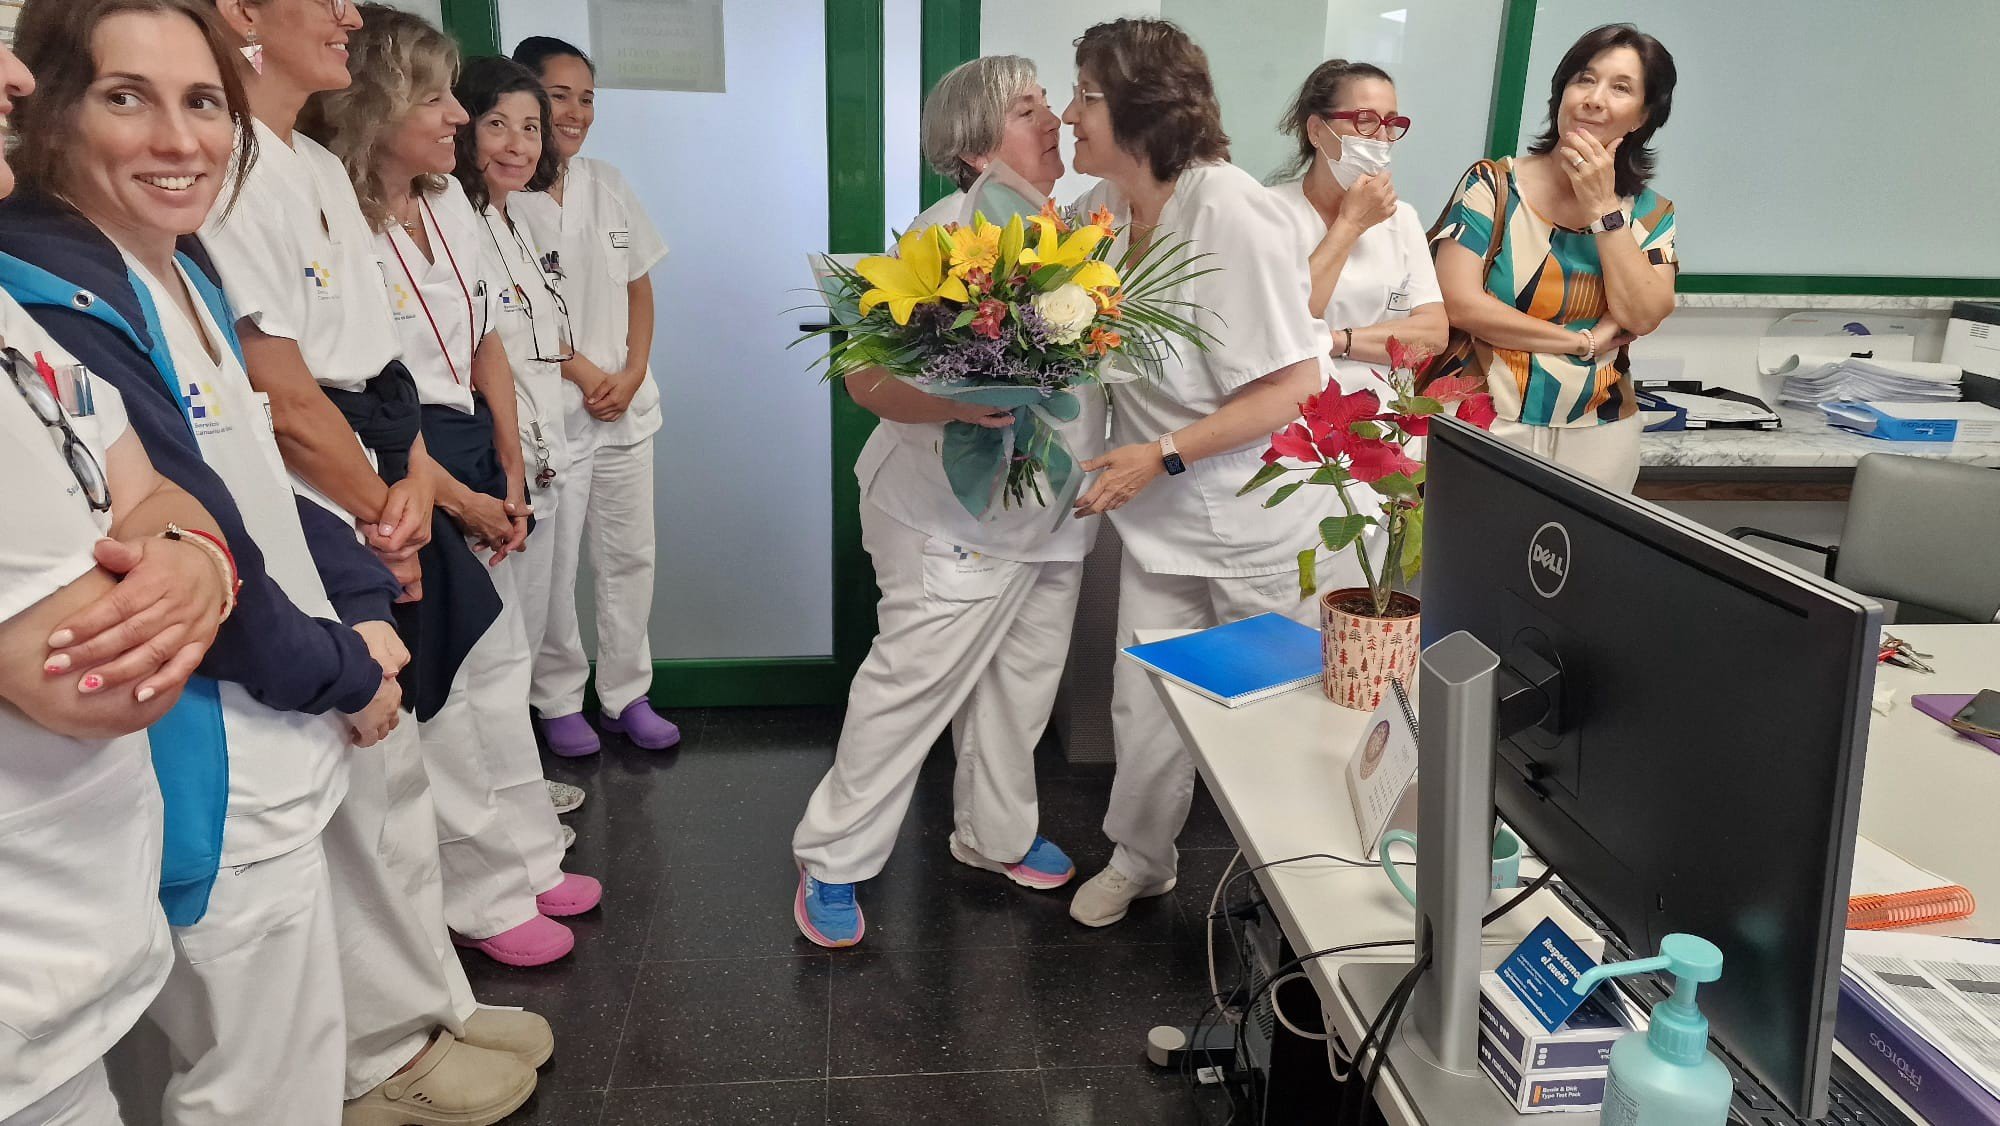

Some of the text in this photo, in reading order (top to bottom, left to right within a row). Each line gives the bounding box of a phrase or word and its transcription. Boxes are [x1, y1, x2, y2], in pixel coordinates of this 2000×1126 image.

[1532, 543, 1563, 577] DELL
[1540, 955, 1570, 987] el sueño
[1541, 937, 1582, 981] Respetamo
